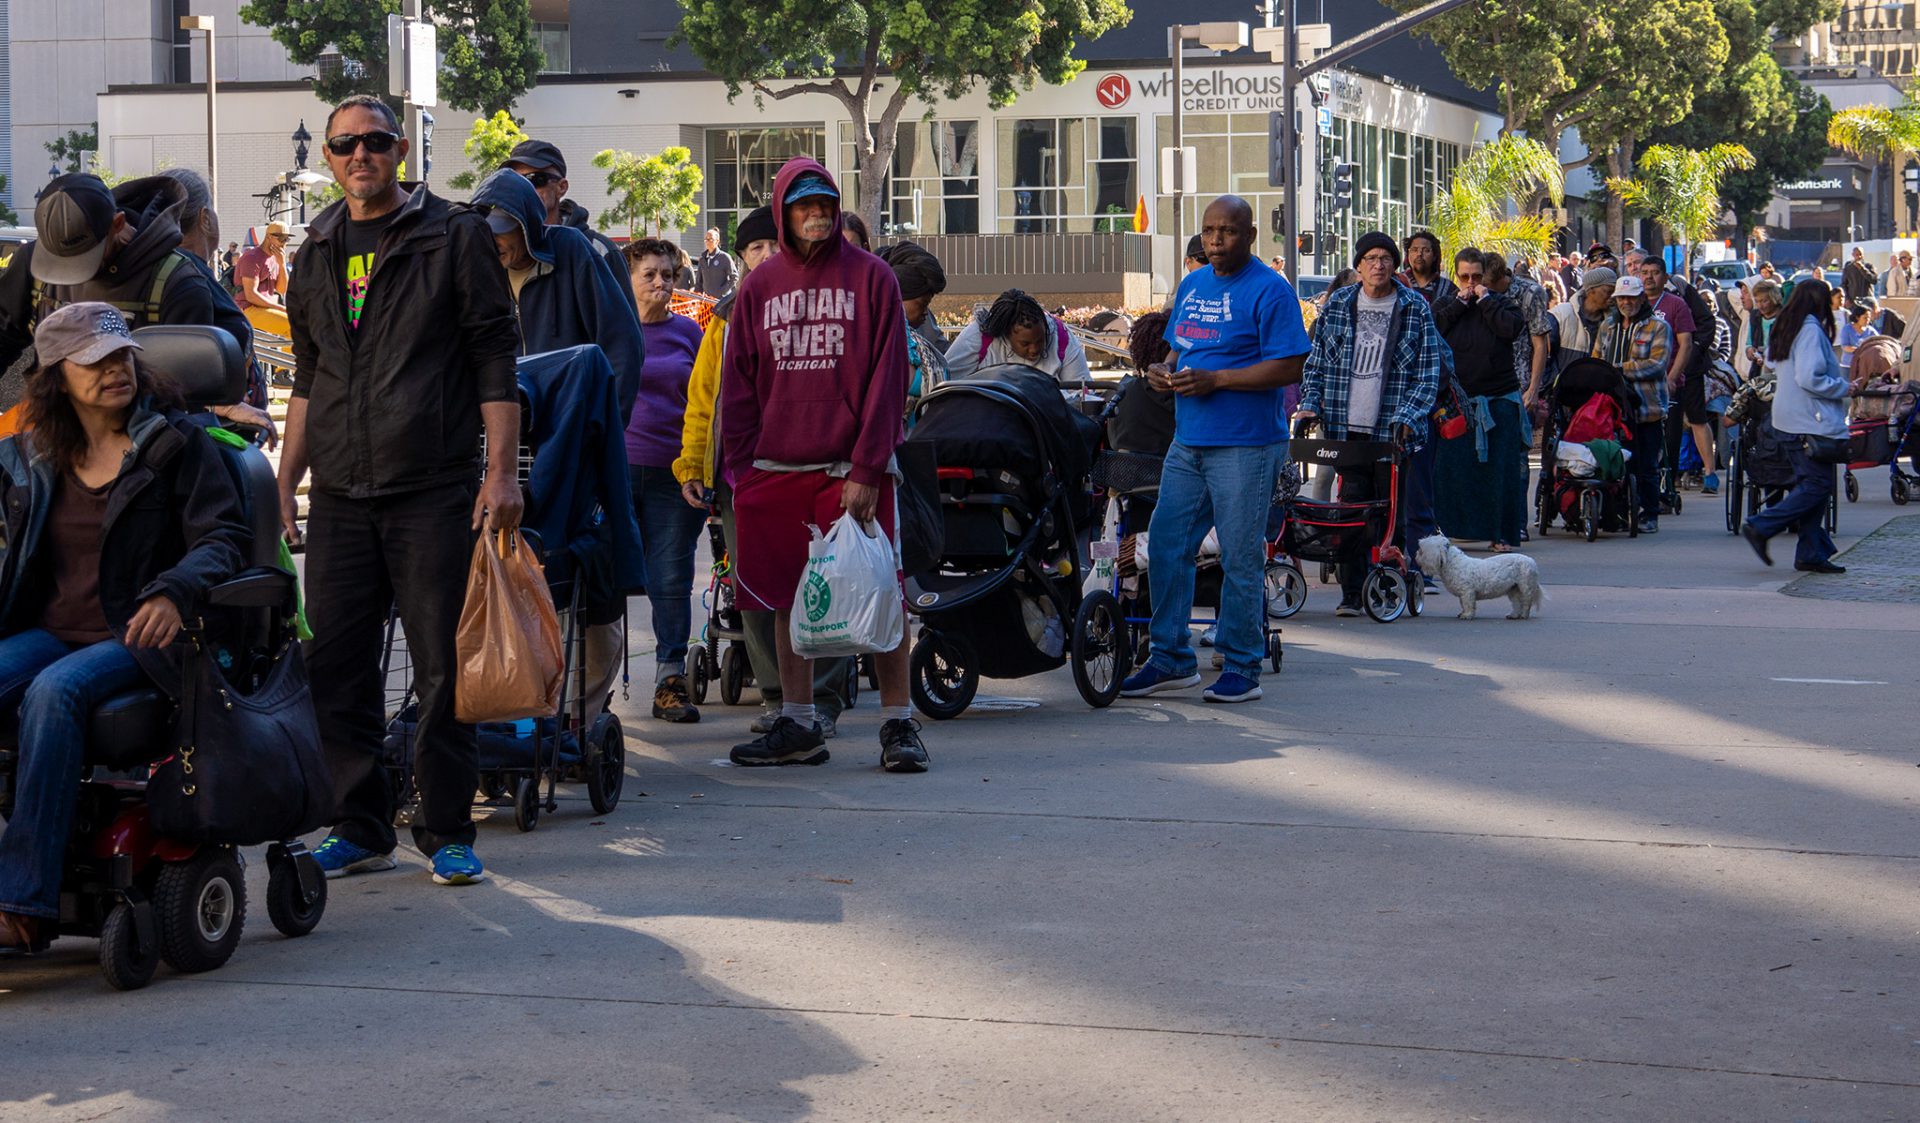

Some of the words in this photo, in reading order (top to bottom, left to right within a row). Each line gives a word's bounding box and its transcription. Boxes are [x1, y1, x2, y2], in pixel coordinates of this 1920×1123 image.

[1138, 70, 1284, 97] wheelhous
[1184, 98, 1240, 110] CREDIT
[763, 288, 855, 330] INDIAN
[1316, 447, 1338, 459] drive
